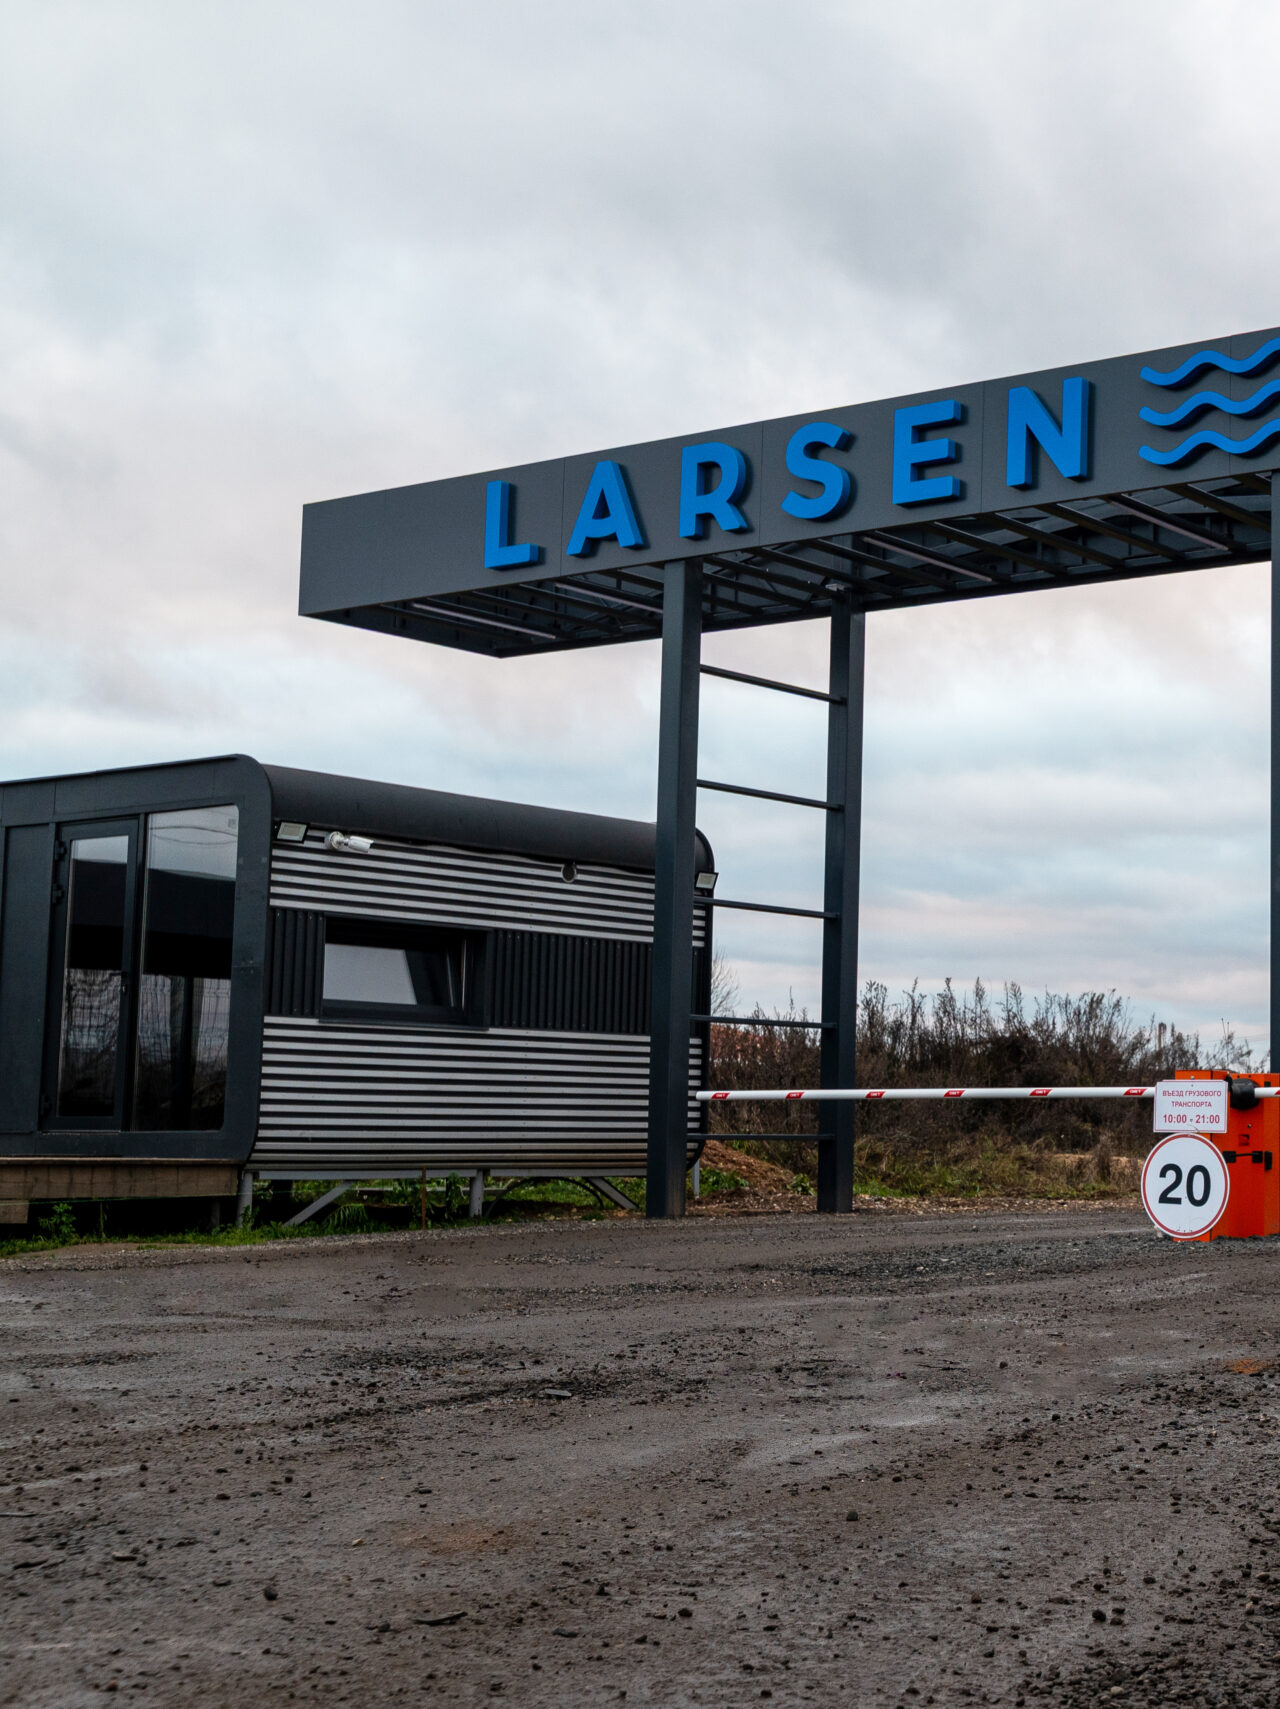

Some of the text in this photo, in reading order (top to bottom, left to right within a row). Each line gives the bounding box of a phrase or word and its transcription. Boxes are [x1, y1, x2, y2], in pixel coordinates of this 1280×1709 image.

[484, 376, 1091, 570] LARSEN
[1163, 1114, 1187, 1124] 10:00
[1195, 1114, 1221, 1124] 21:00
[1158, 1163, 1212, 1207] 20
